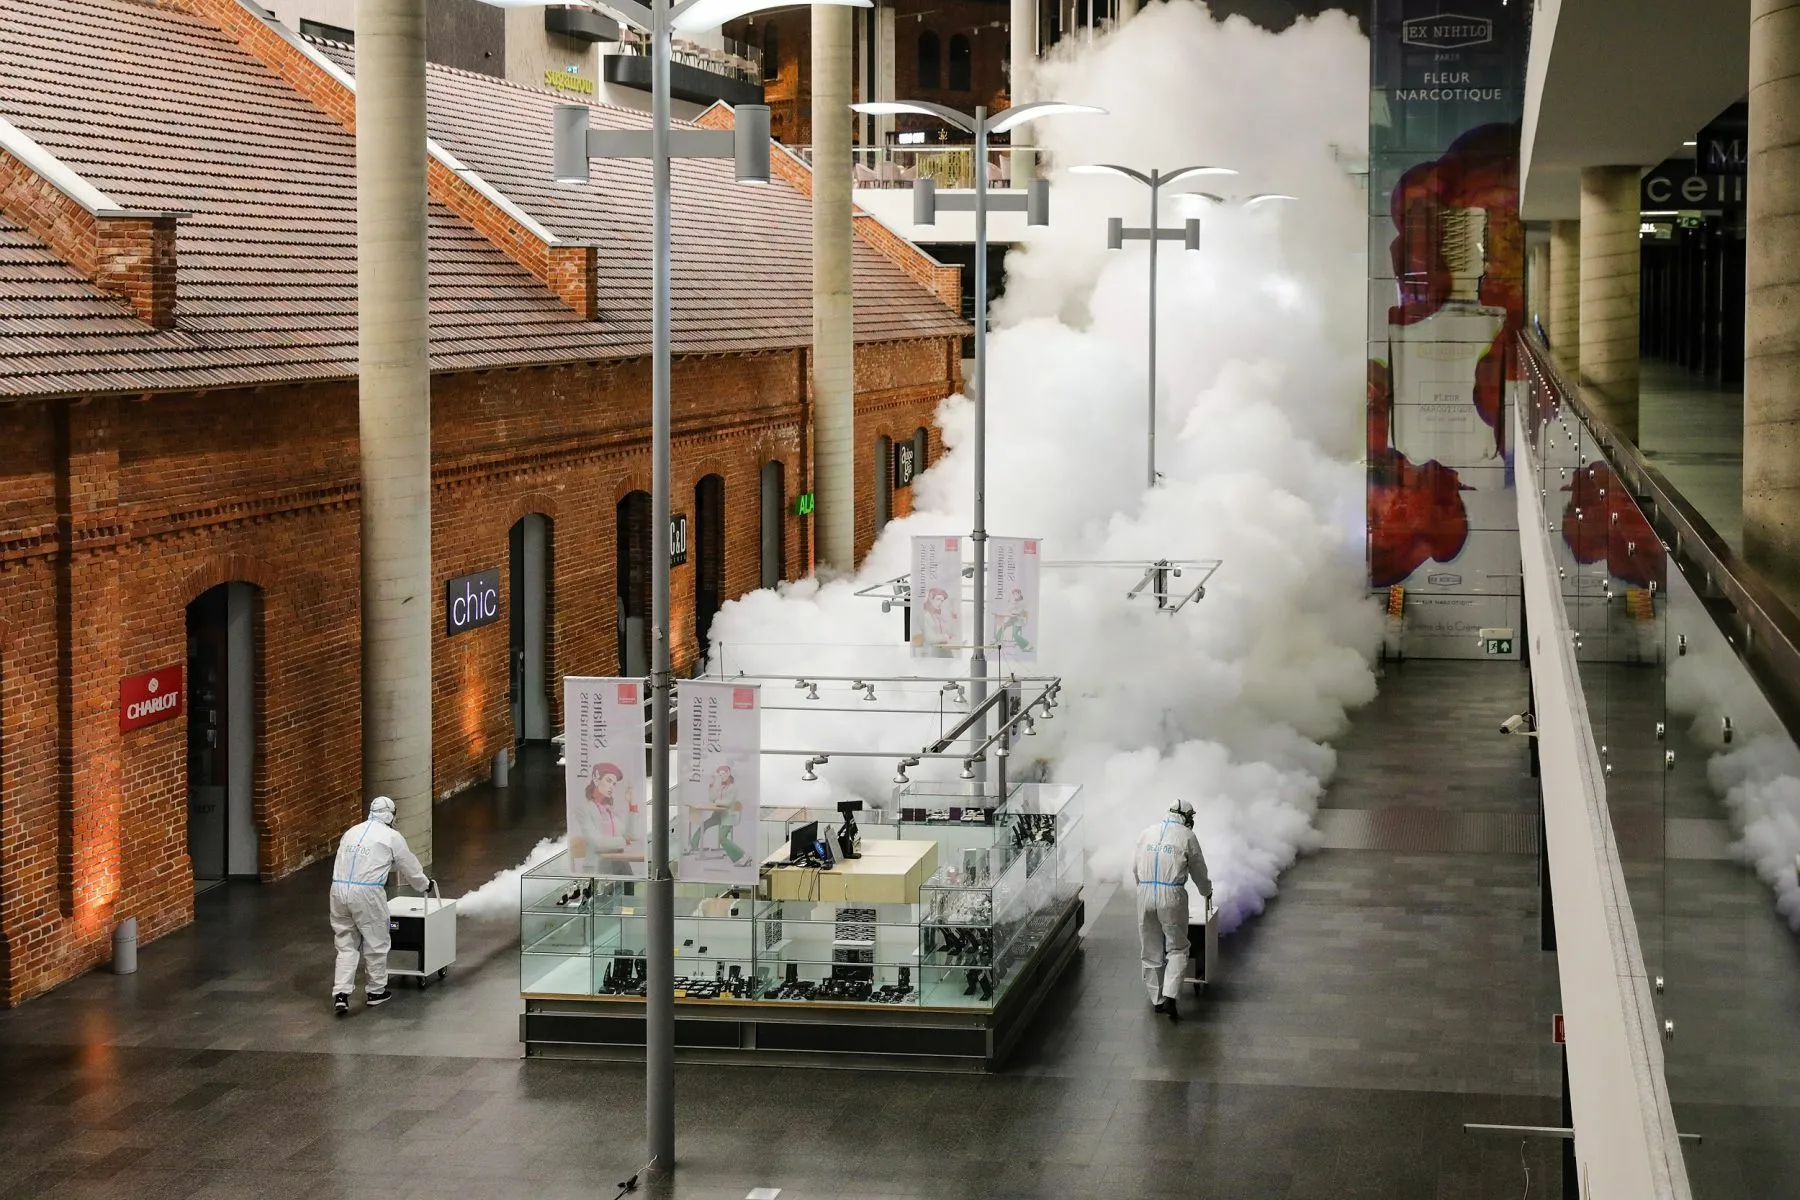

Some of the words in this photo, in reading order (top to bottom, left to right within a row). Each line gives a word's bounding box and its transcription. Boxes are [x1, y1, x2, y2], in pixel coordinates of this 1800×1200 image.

[1408, 26, 1428, 39] EX
[1433, 24, 1487, 38] NIHILO
[1424, 72, 1470, 84] FLEUR
[1395, 88, 1502, 102] NARCOTIQUE
[453, 580, 496, 626] chic
[127, 691, 179, 720] CHARLOT
